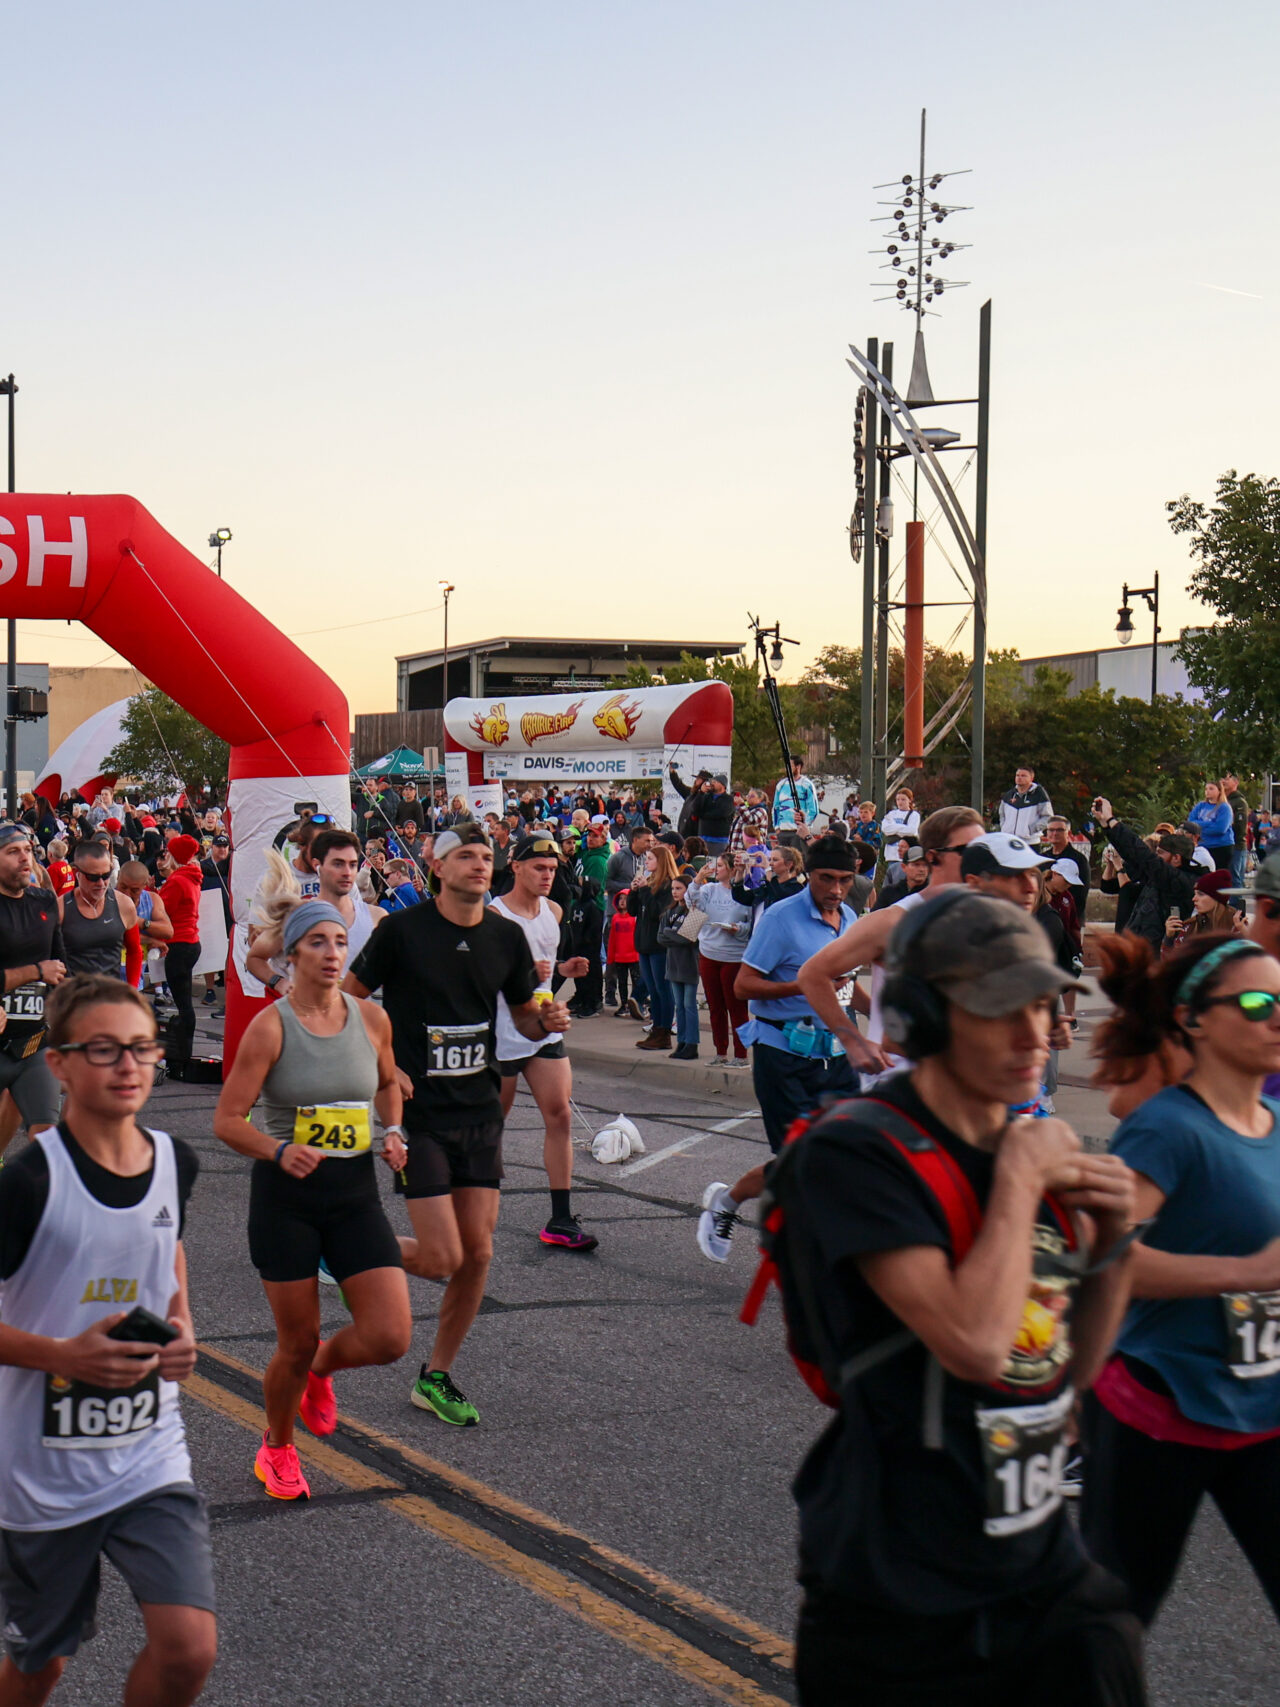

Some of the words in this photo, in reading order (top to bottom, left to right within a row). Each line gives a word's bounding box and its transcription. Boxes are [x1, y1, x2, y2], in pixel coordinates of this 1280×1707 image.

[521, 713, 554, 746] PRAIRIE
[524, 757, 565, 769] DAVIS
[572, 760, 626, 773] MOORE
[1, 995, 44, 1014] 1140
[432, 1043, 486, 1069] 1612
[307, 1123, 357, 1149] 243
[80, 1277, 139, 1304] ALVA
[1236, 1319, 1280, 1363] 14
[51, 1390, 156, 1436] 1692
[994, 1443, 1068, 1515] 16
